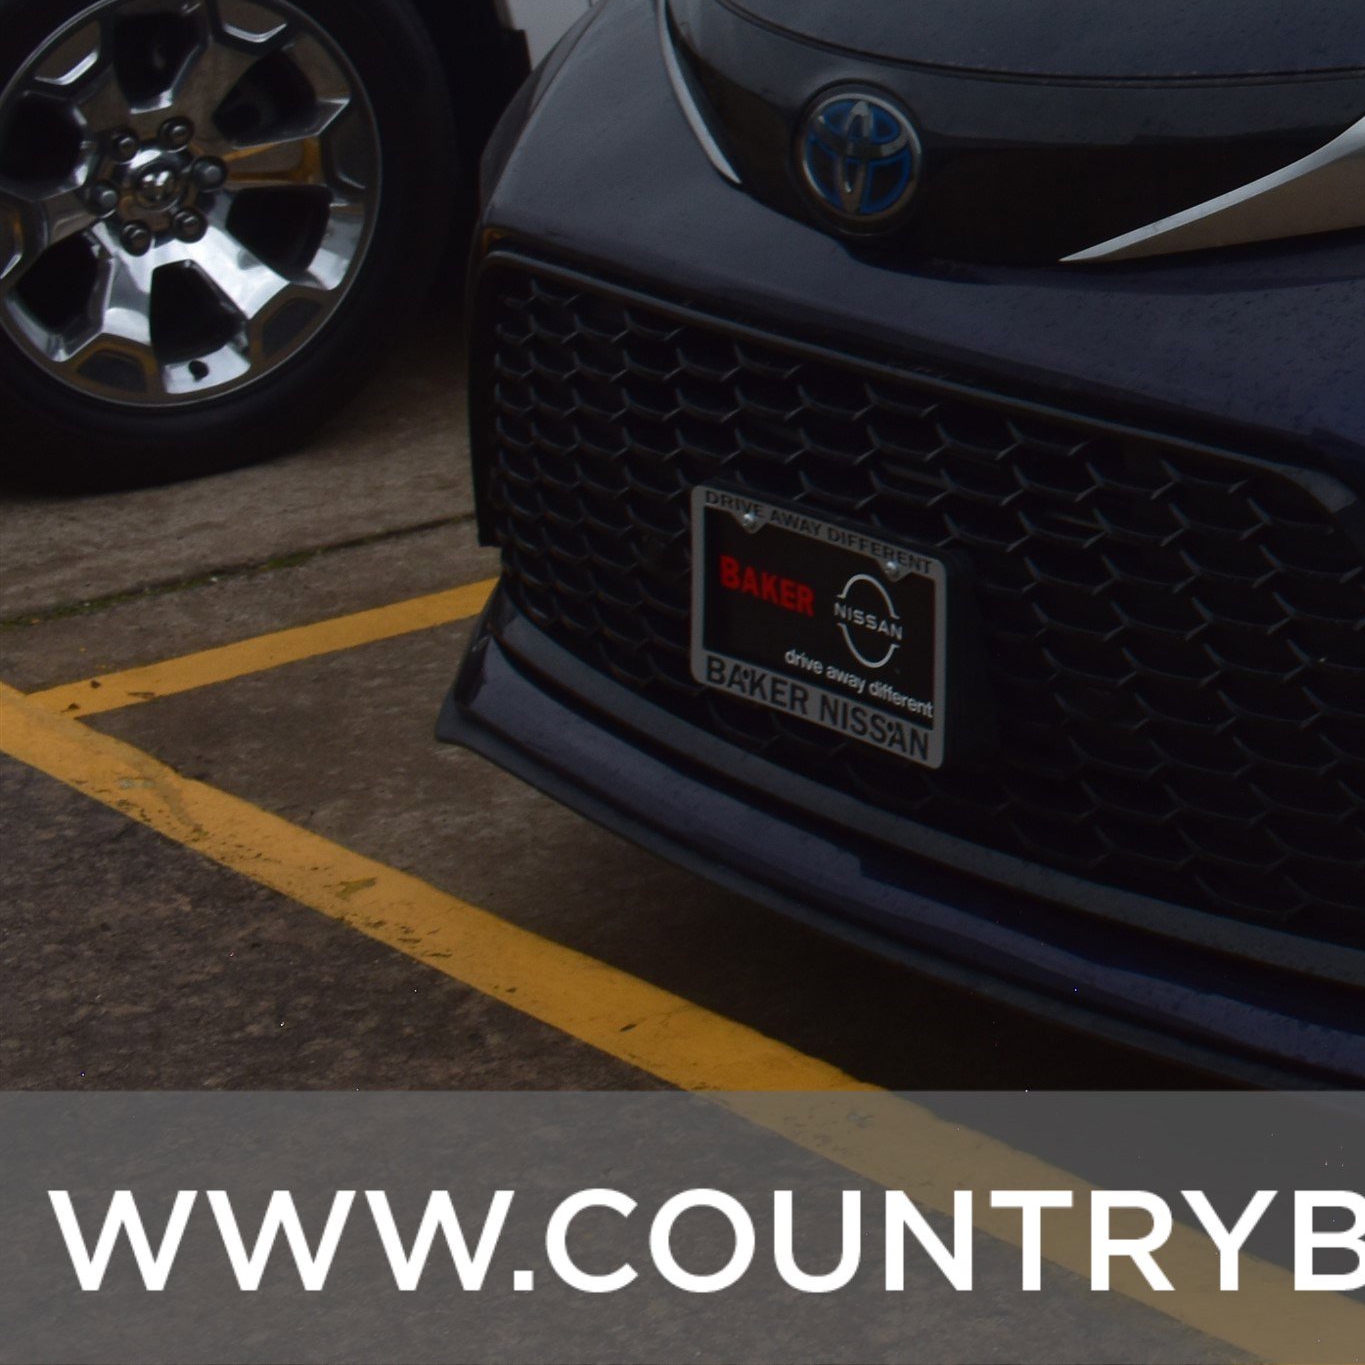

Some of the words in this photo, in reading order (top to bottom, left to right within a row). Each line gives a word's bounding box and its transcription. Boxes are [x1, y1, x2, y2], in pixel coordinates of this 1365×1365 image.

[705, 490, 764, 519] DRIVE
[769, 508, 822, 537] AWAY
[827, 526, 932, 574] DIFFERENT
[718, 554, 816, 617] BAKER
[833, 601, 904, 641] NISSAN
[706, 654, 809, 716] BAKER
[820, 692, 929, 762] NISSAN
[784, 648, 823, 675] drive
[826, 664, 867, 694] away
[868, 679, 934, 718] different
